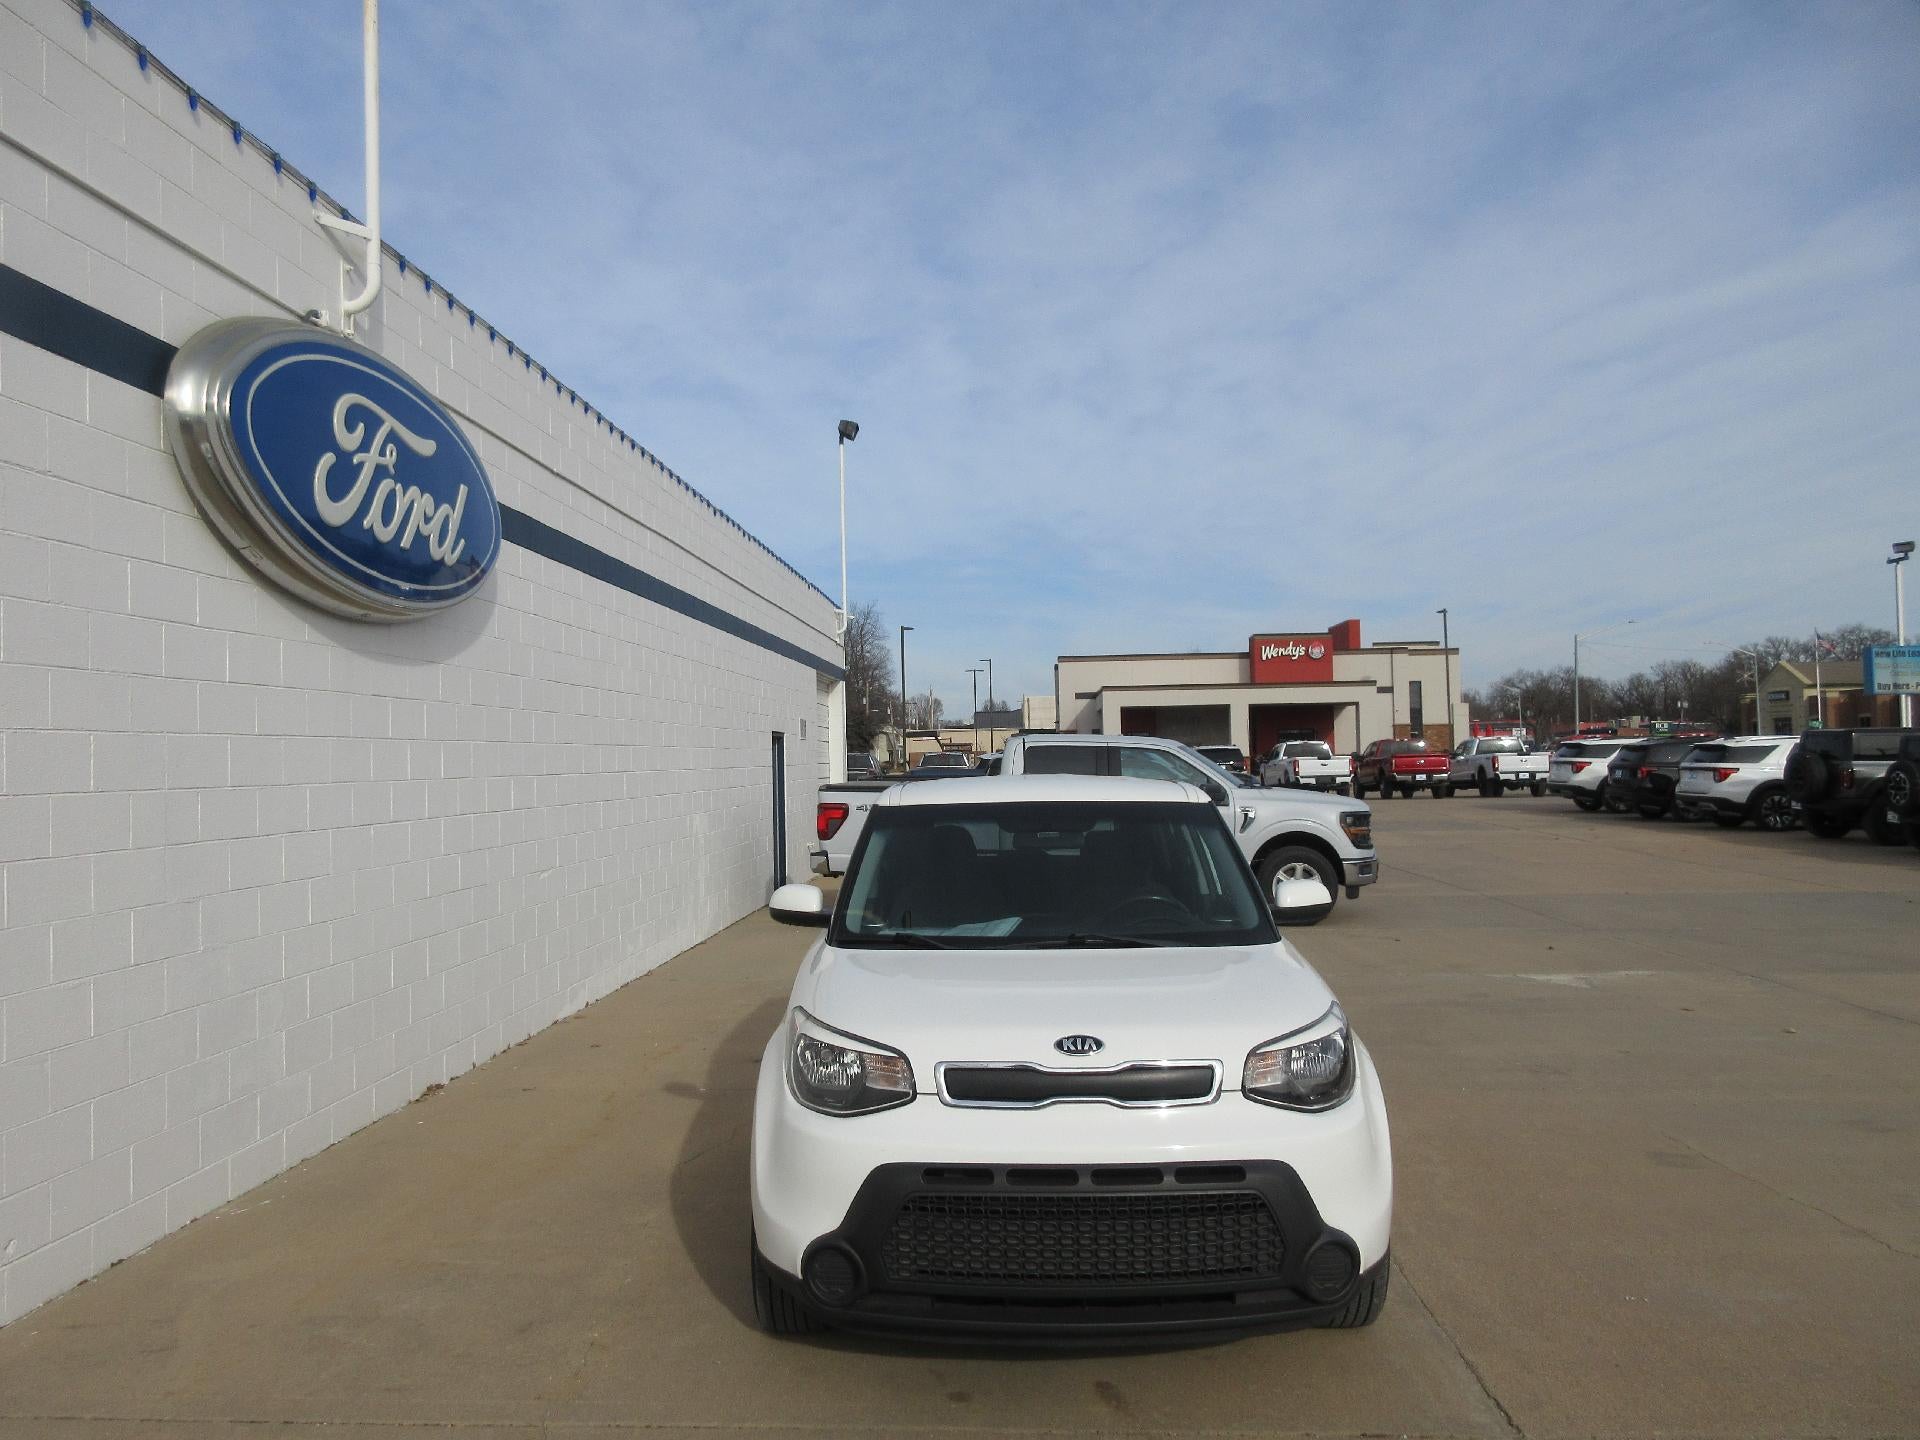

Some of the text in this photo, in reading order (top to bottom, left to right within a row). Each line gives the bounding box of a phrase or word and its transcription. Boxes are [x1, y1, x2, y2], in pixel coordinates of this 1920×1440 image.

[313, 393, 469, 567] Ford
[1261, 641, 1306, 660] Wendy's
[1062, 1037, 1098, 1051] KIA
